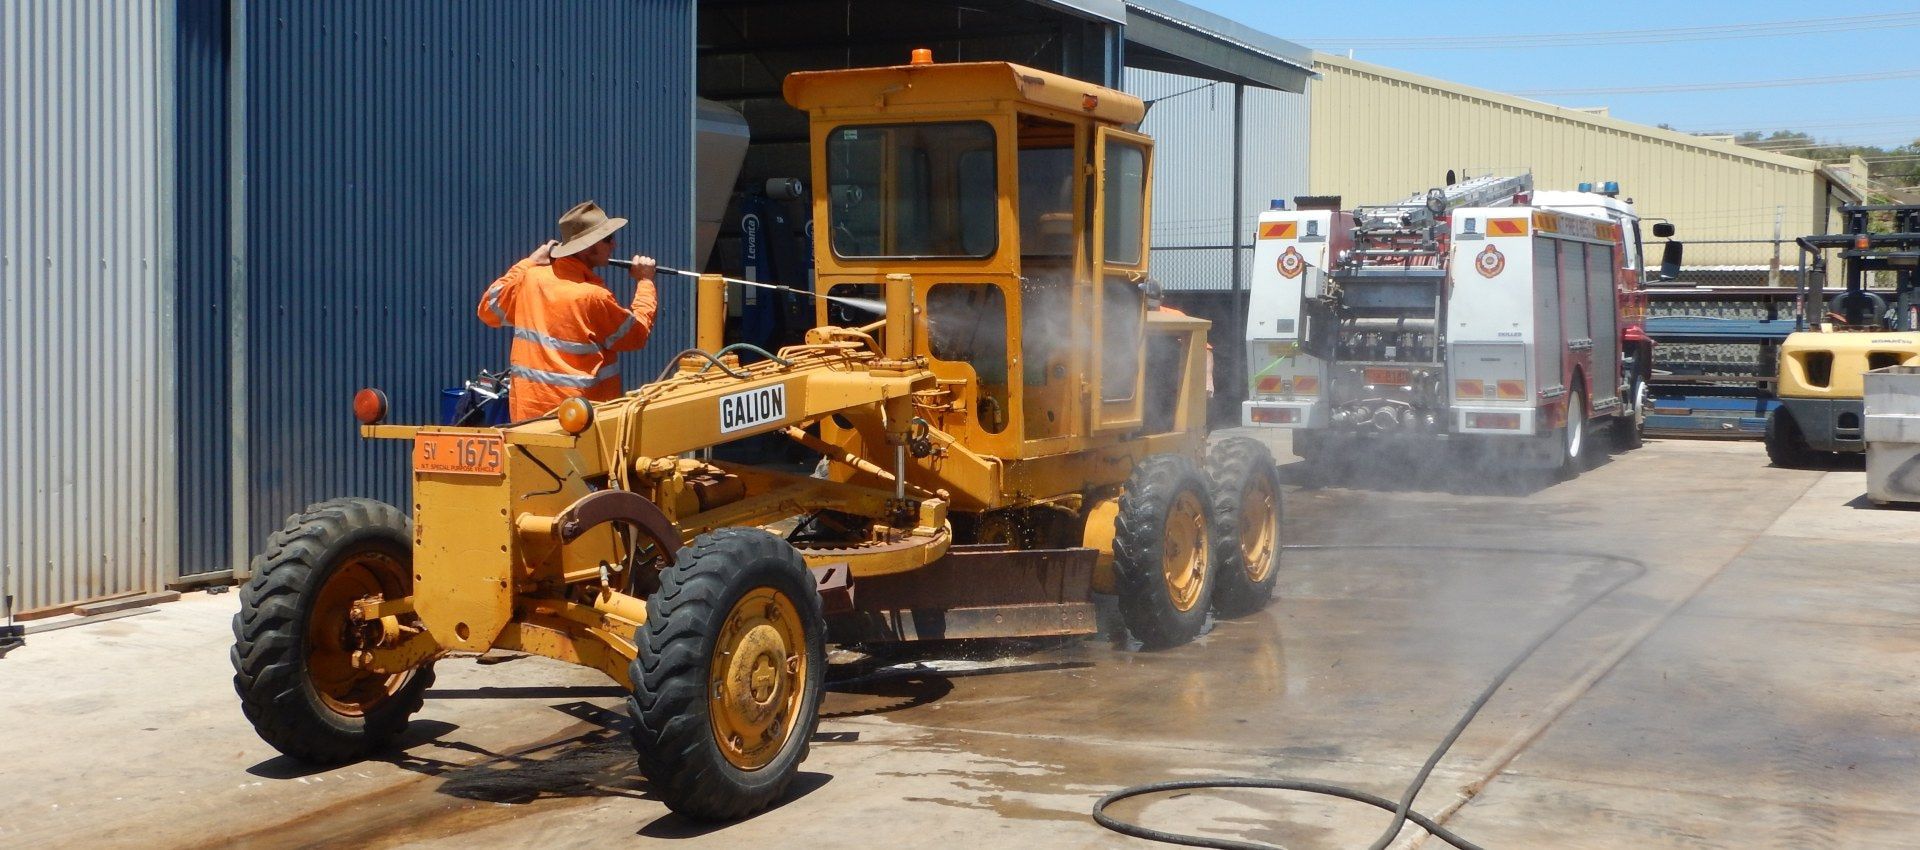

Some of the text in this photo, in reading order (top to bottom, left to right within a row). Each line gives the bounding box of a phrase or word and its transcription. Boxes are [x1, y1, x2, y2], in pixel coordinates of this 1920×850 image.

[748, 219, 756, 260] Levanta
[723, 387, 783, 429] GALION
[423, 442, 437, 460] SV
